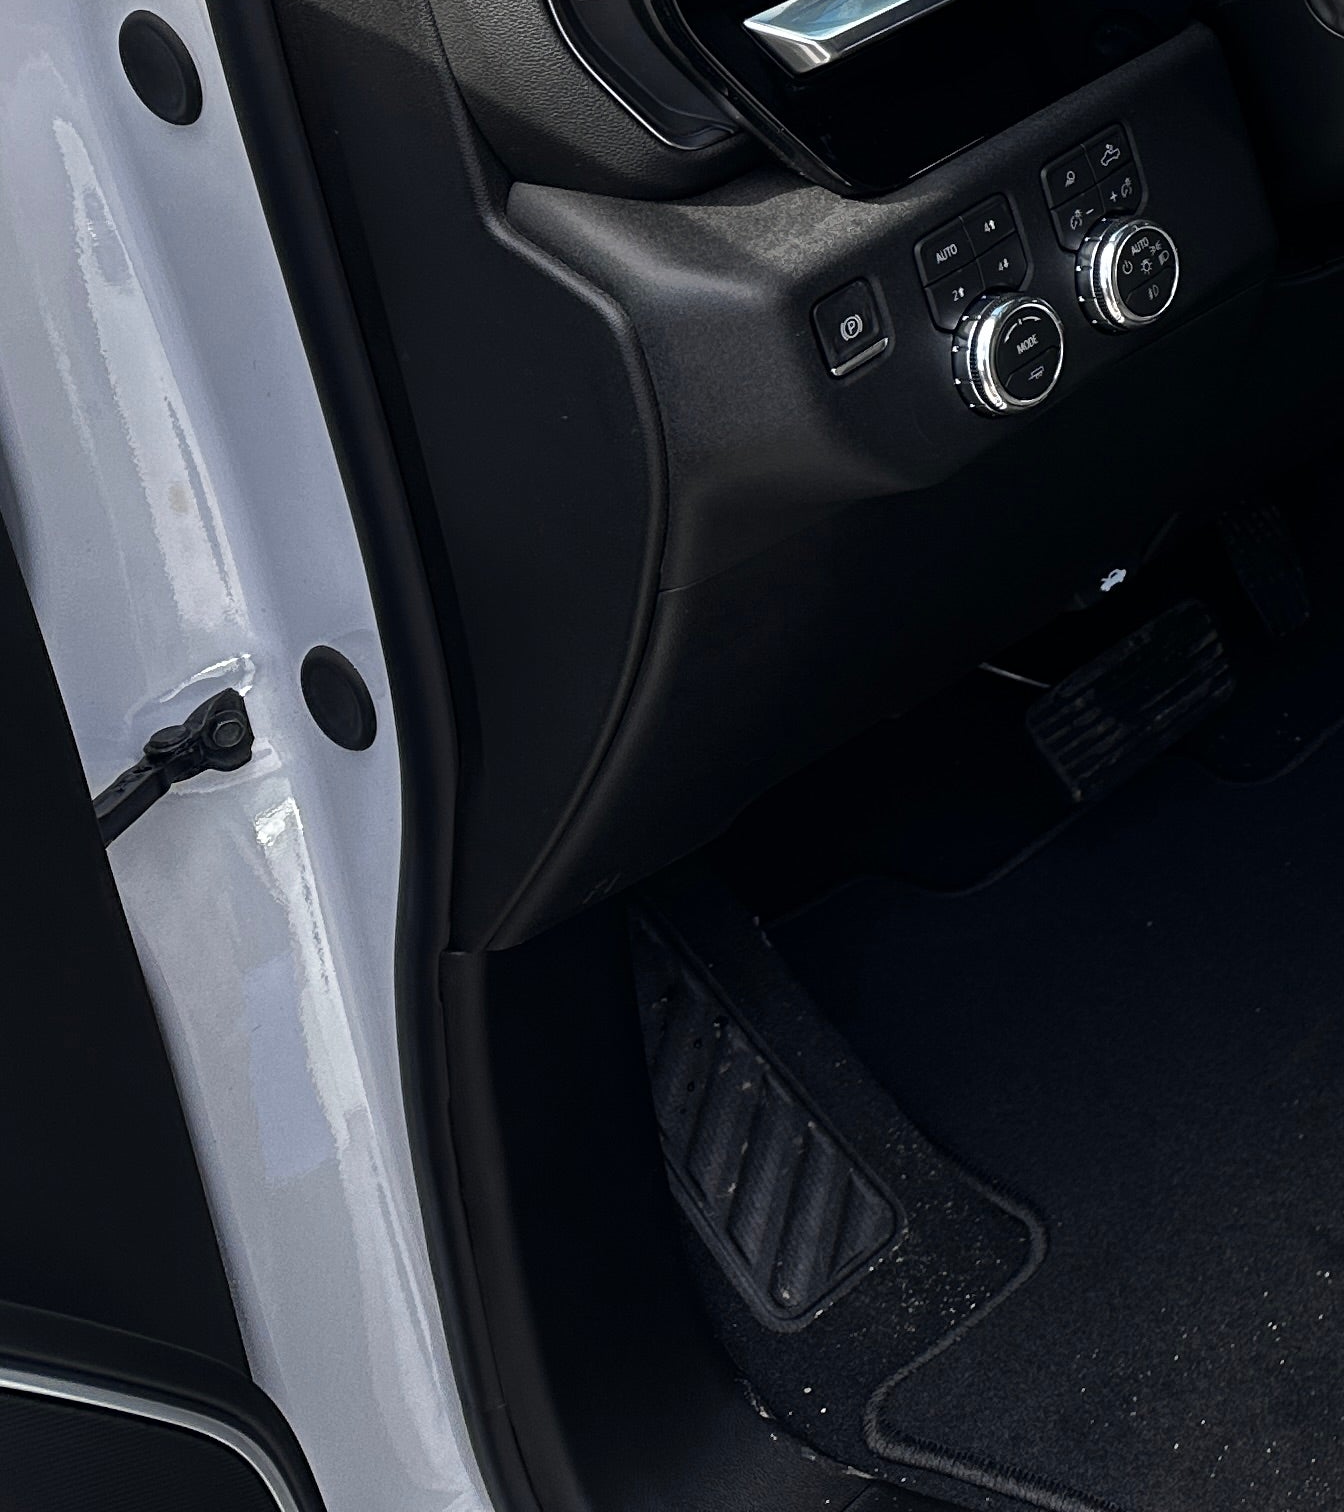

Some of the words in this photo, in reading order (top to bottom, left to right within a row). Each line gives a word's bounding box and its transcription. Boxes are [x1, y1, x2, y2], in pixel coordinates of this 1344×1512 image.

[935, 243, 959, 265] AUTO
[1131, 236, 1150, 256] AUTO
[1016, 333, 1040, 355] MODE
